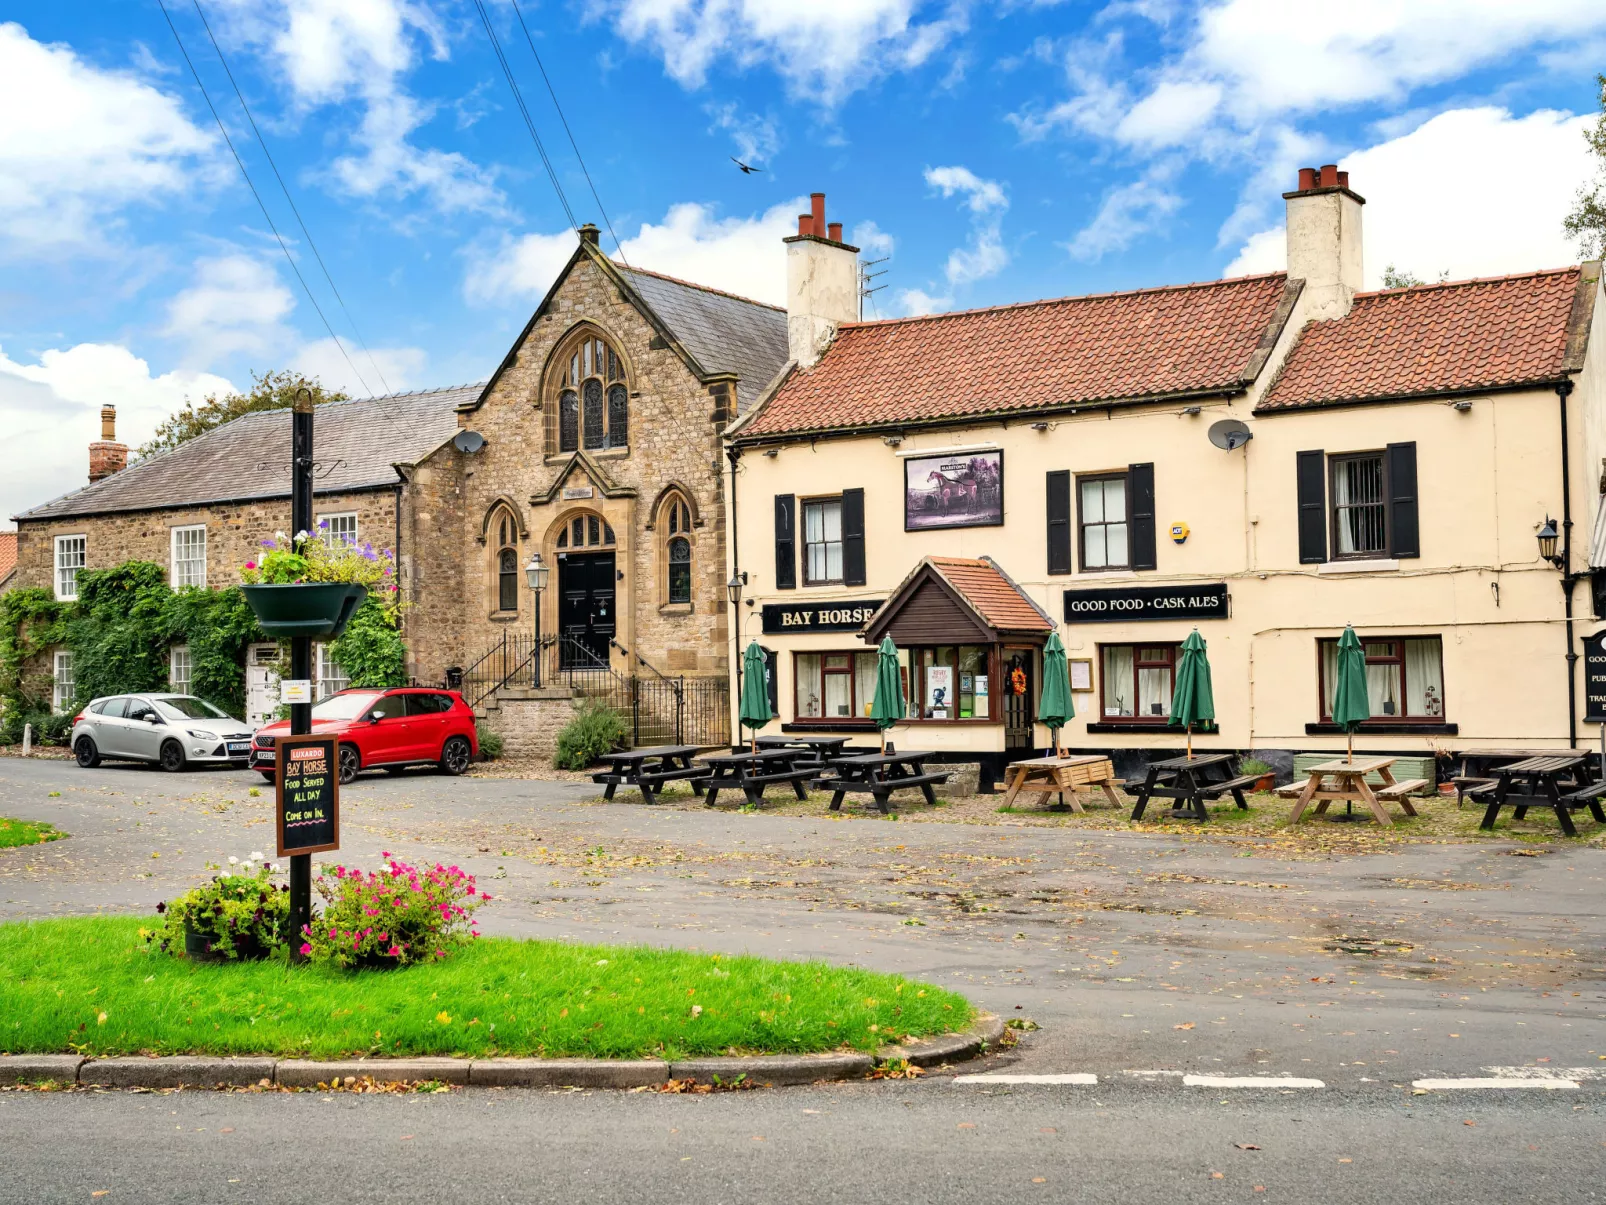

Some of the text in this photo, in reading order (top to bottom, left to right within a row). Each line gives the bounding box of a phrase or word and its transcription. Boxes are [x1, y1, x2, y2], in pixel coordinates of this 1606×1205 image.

[1071, 596, 1219, 611] GOOD FOOD CASK ALES
[782, 611, 813, 626] BAY
[292, 749, 323, 759] LUXARDO
[287, 760, 327, 774] BAY HORSE
[285, 777, 324, 790] FOOD SERVED
[294, 790, 321, 802] ALL DAY
[285, 811, 302, 822] COME
[304, 811, 312, 819] ON
